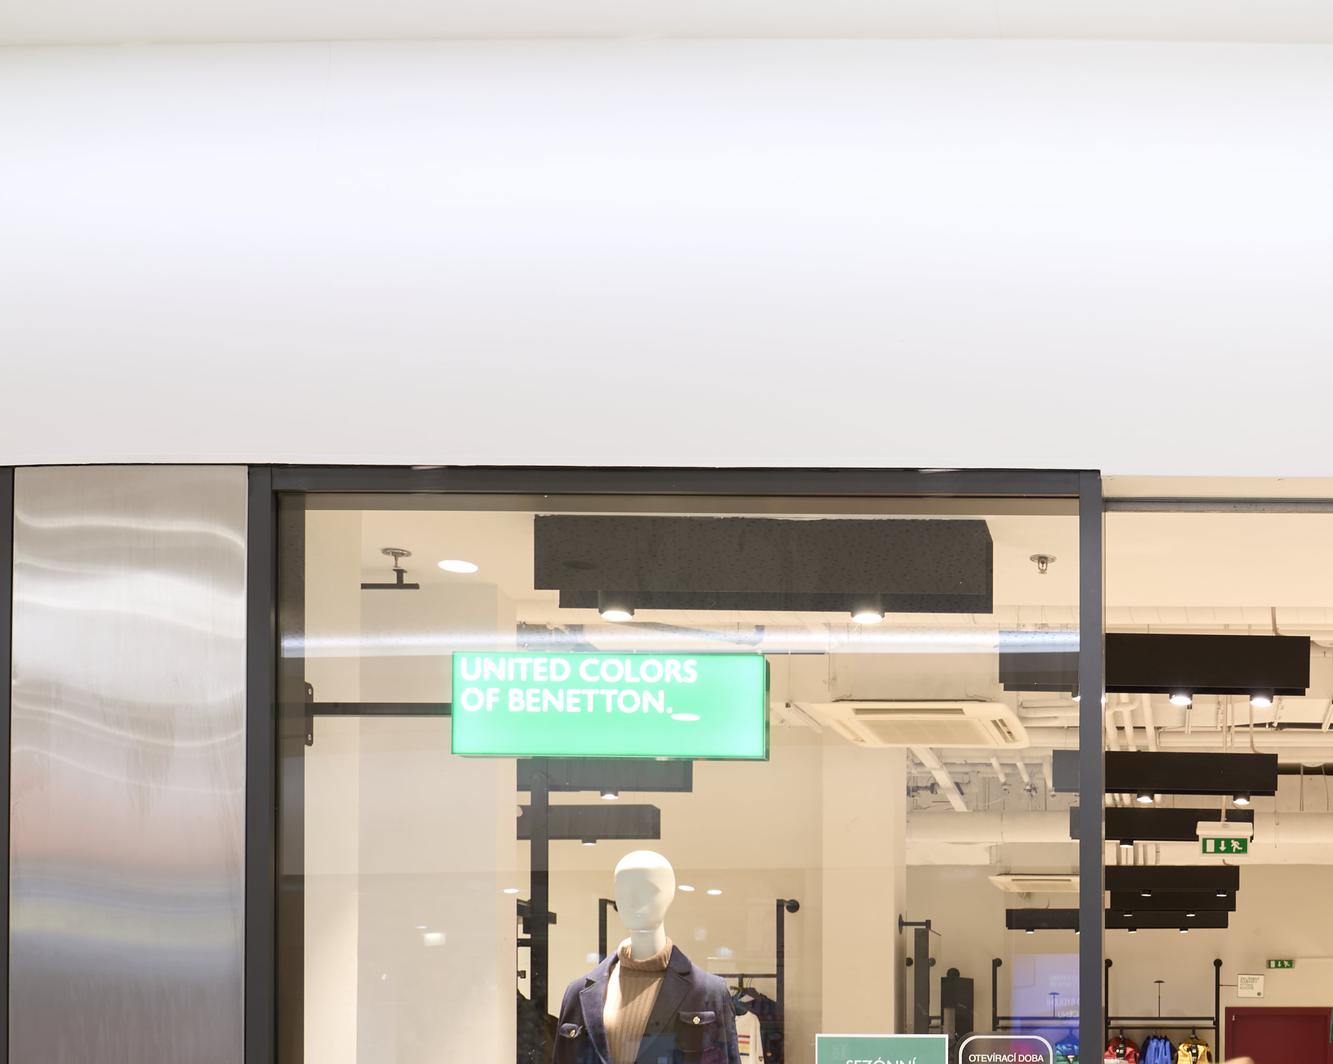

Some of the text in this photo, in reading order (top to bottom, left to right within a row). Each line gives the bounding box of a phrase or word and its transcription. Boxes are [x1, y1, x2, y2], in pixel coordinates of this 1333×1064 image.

[460, 657, 697, 683] UNITED COLORS
[460, 687, 673, 714] OF BENETTON.
[968, 1052, 1044, 1062] OTEVÍRACÍ DOBA
